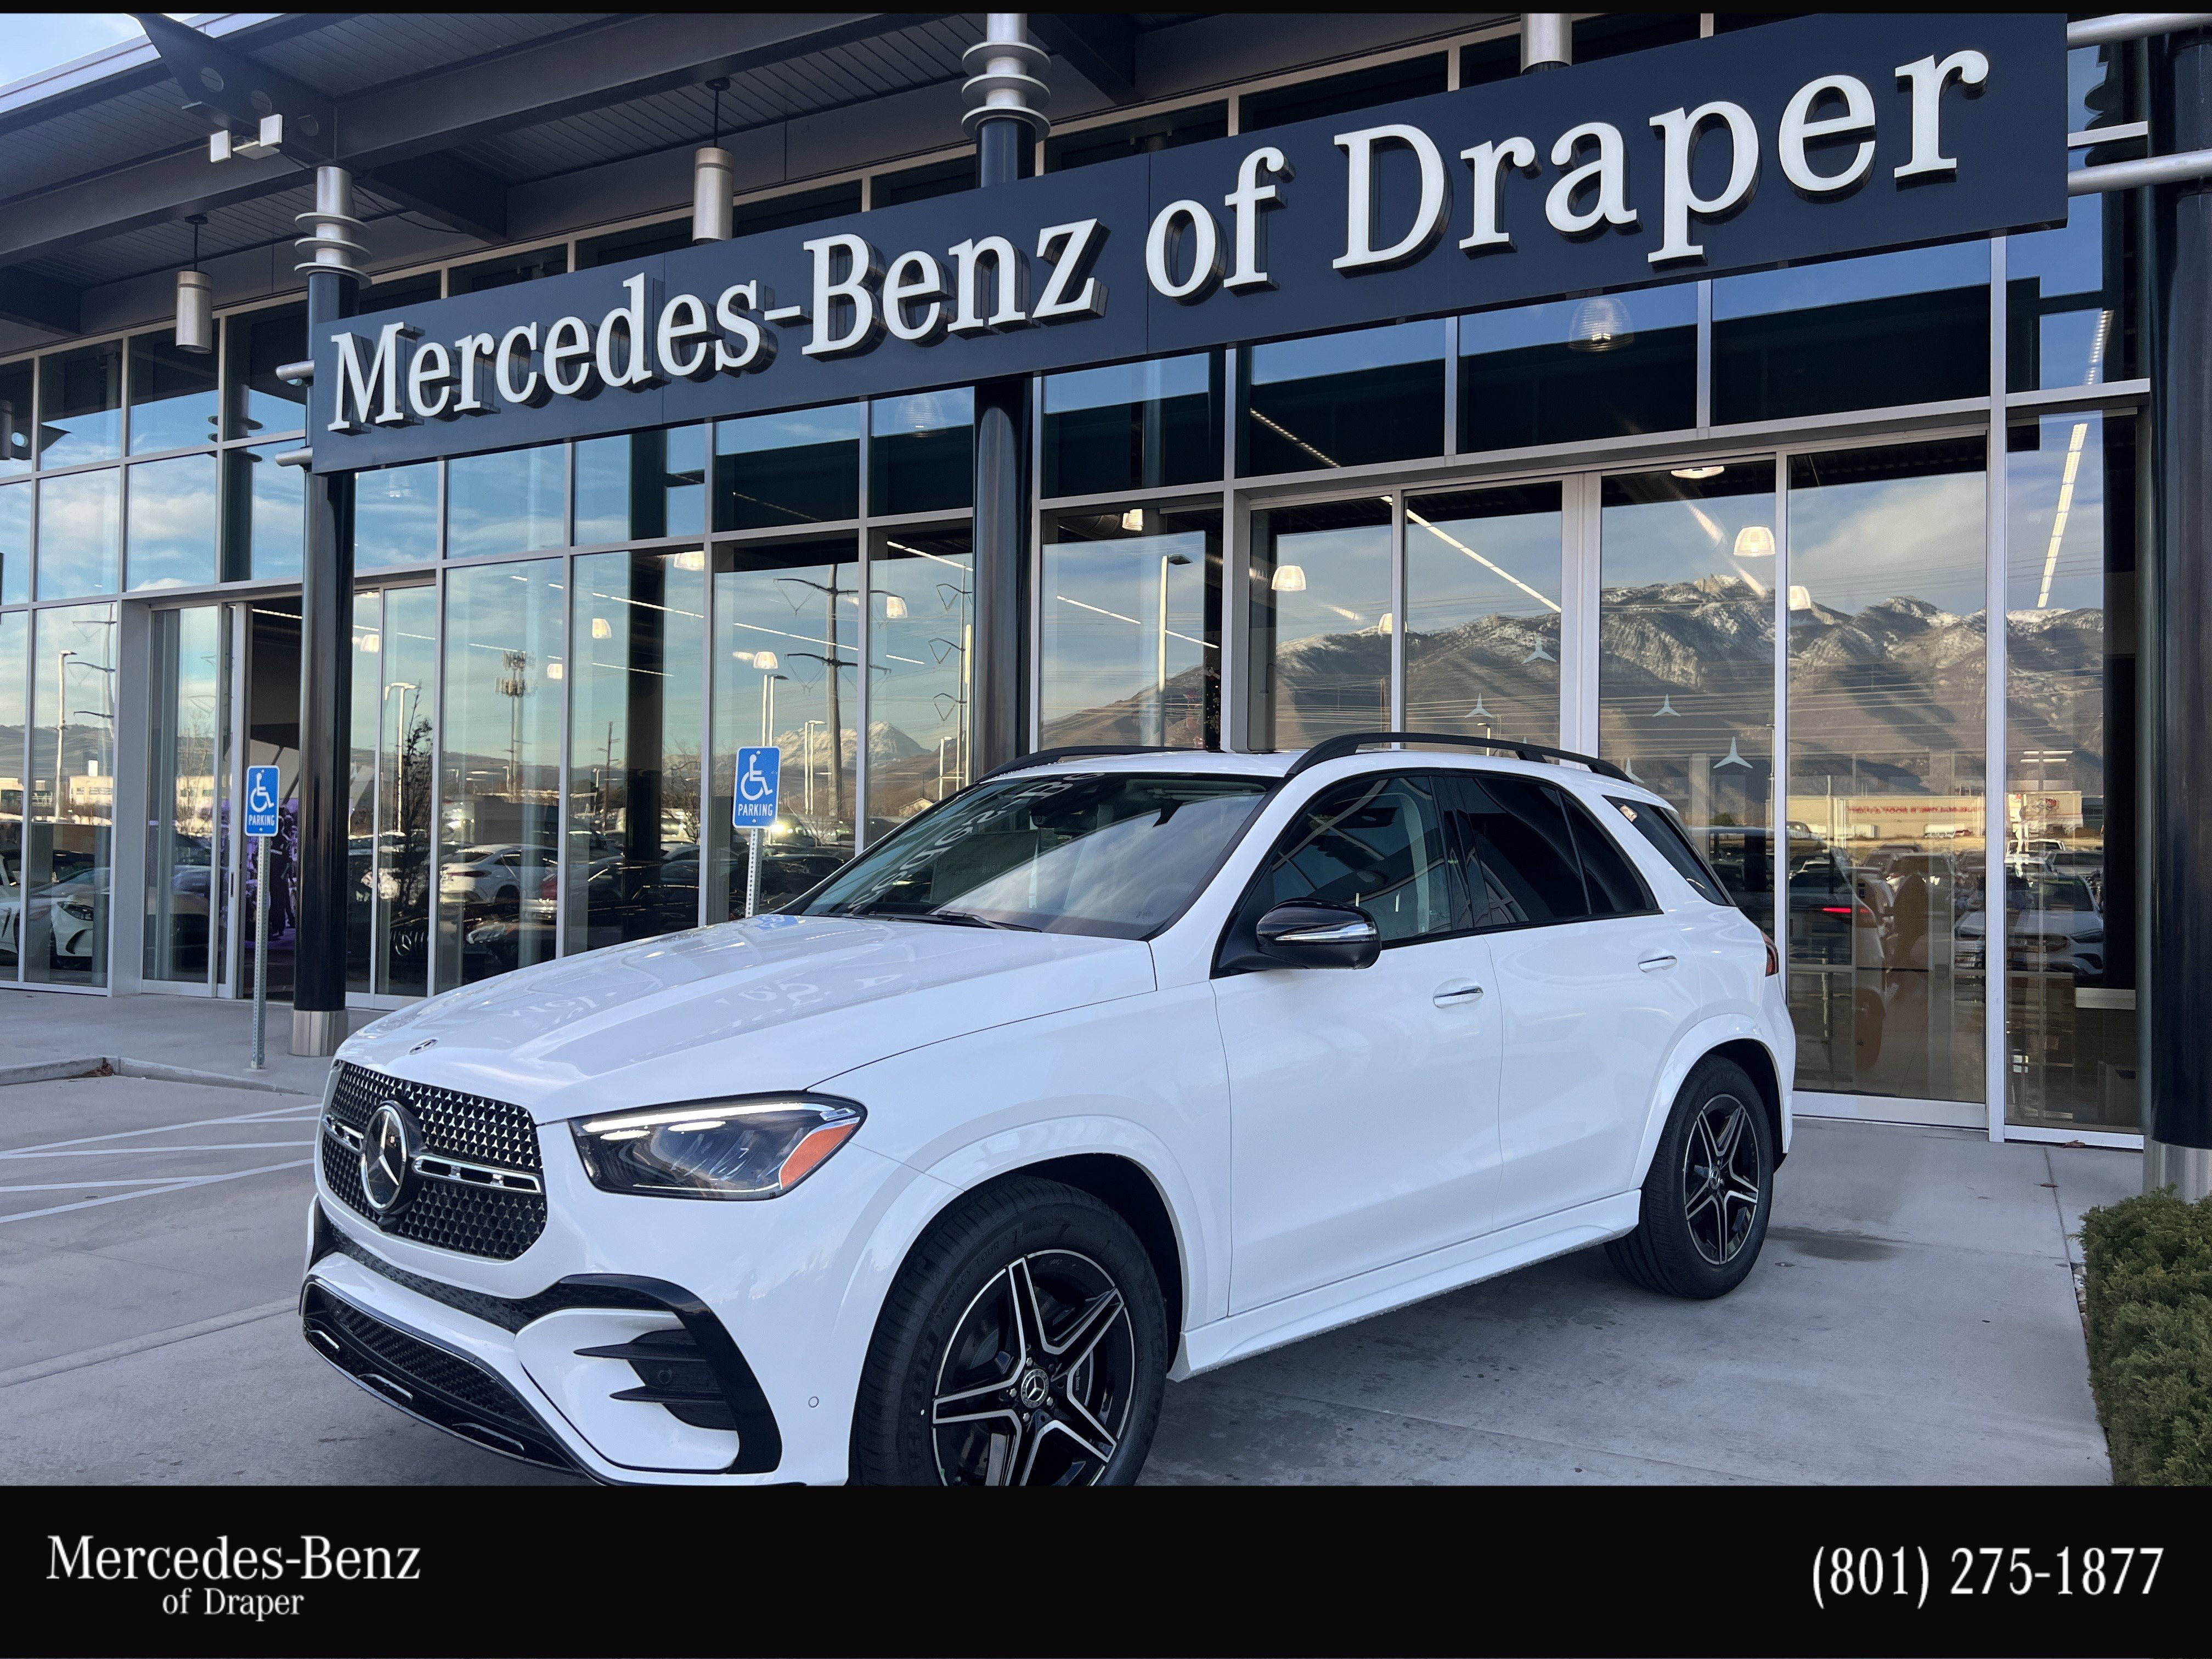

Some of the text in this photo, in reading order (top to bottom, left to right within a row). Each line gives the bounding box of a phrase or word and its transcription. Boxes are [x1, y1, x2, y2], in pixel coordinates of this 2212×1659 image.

[327, 49, 1990, 433] Mercedes-Benz of Draper
[737, 803, 774, 816] PARKING
[249, 814, 275, 826] PARKING
